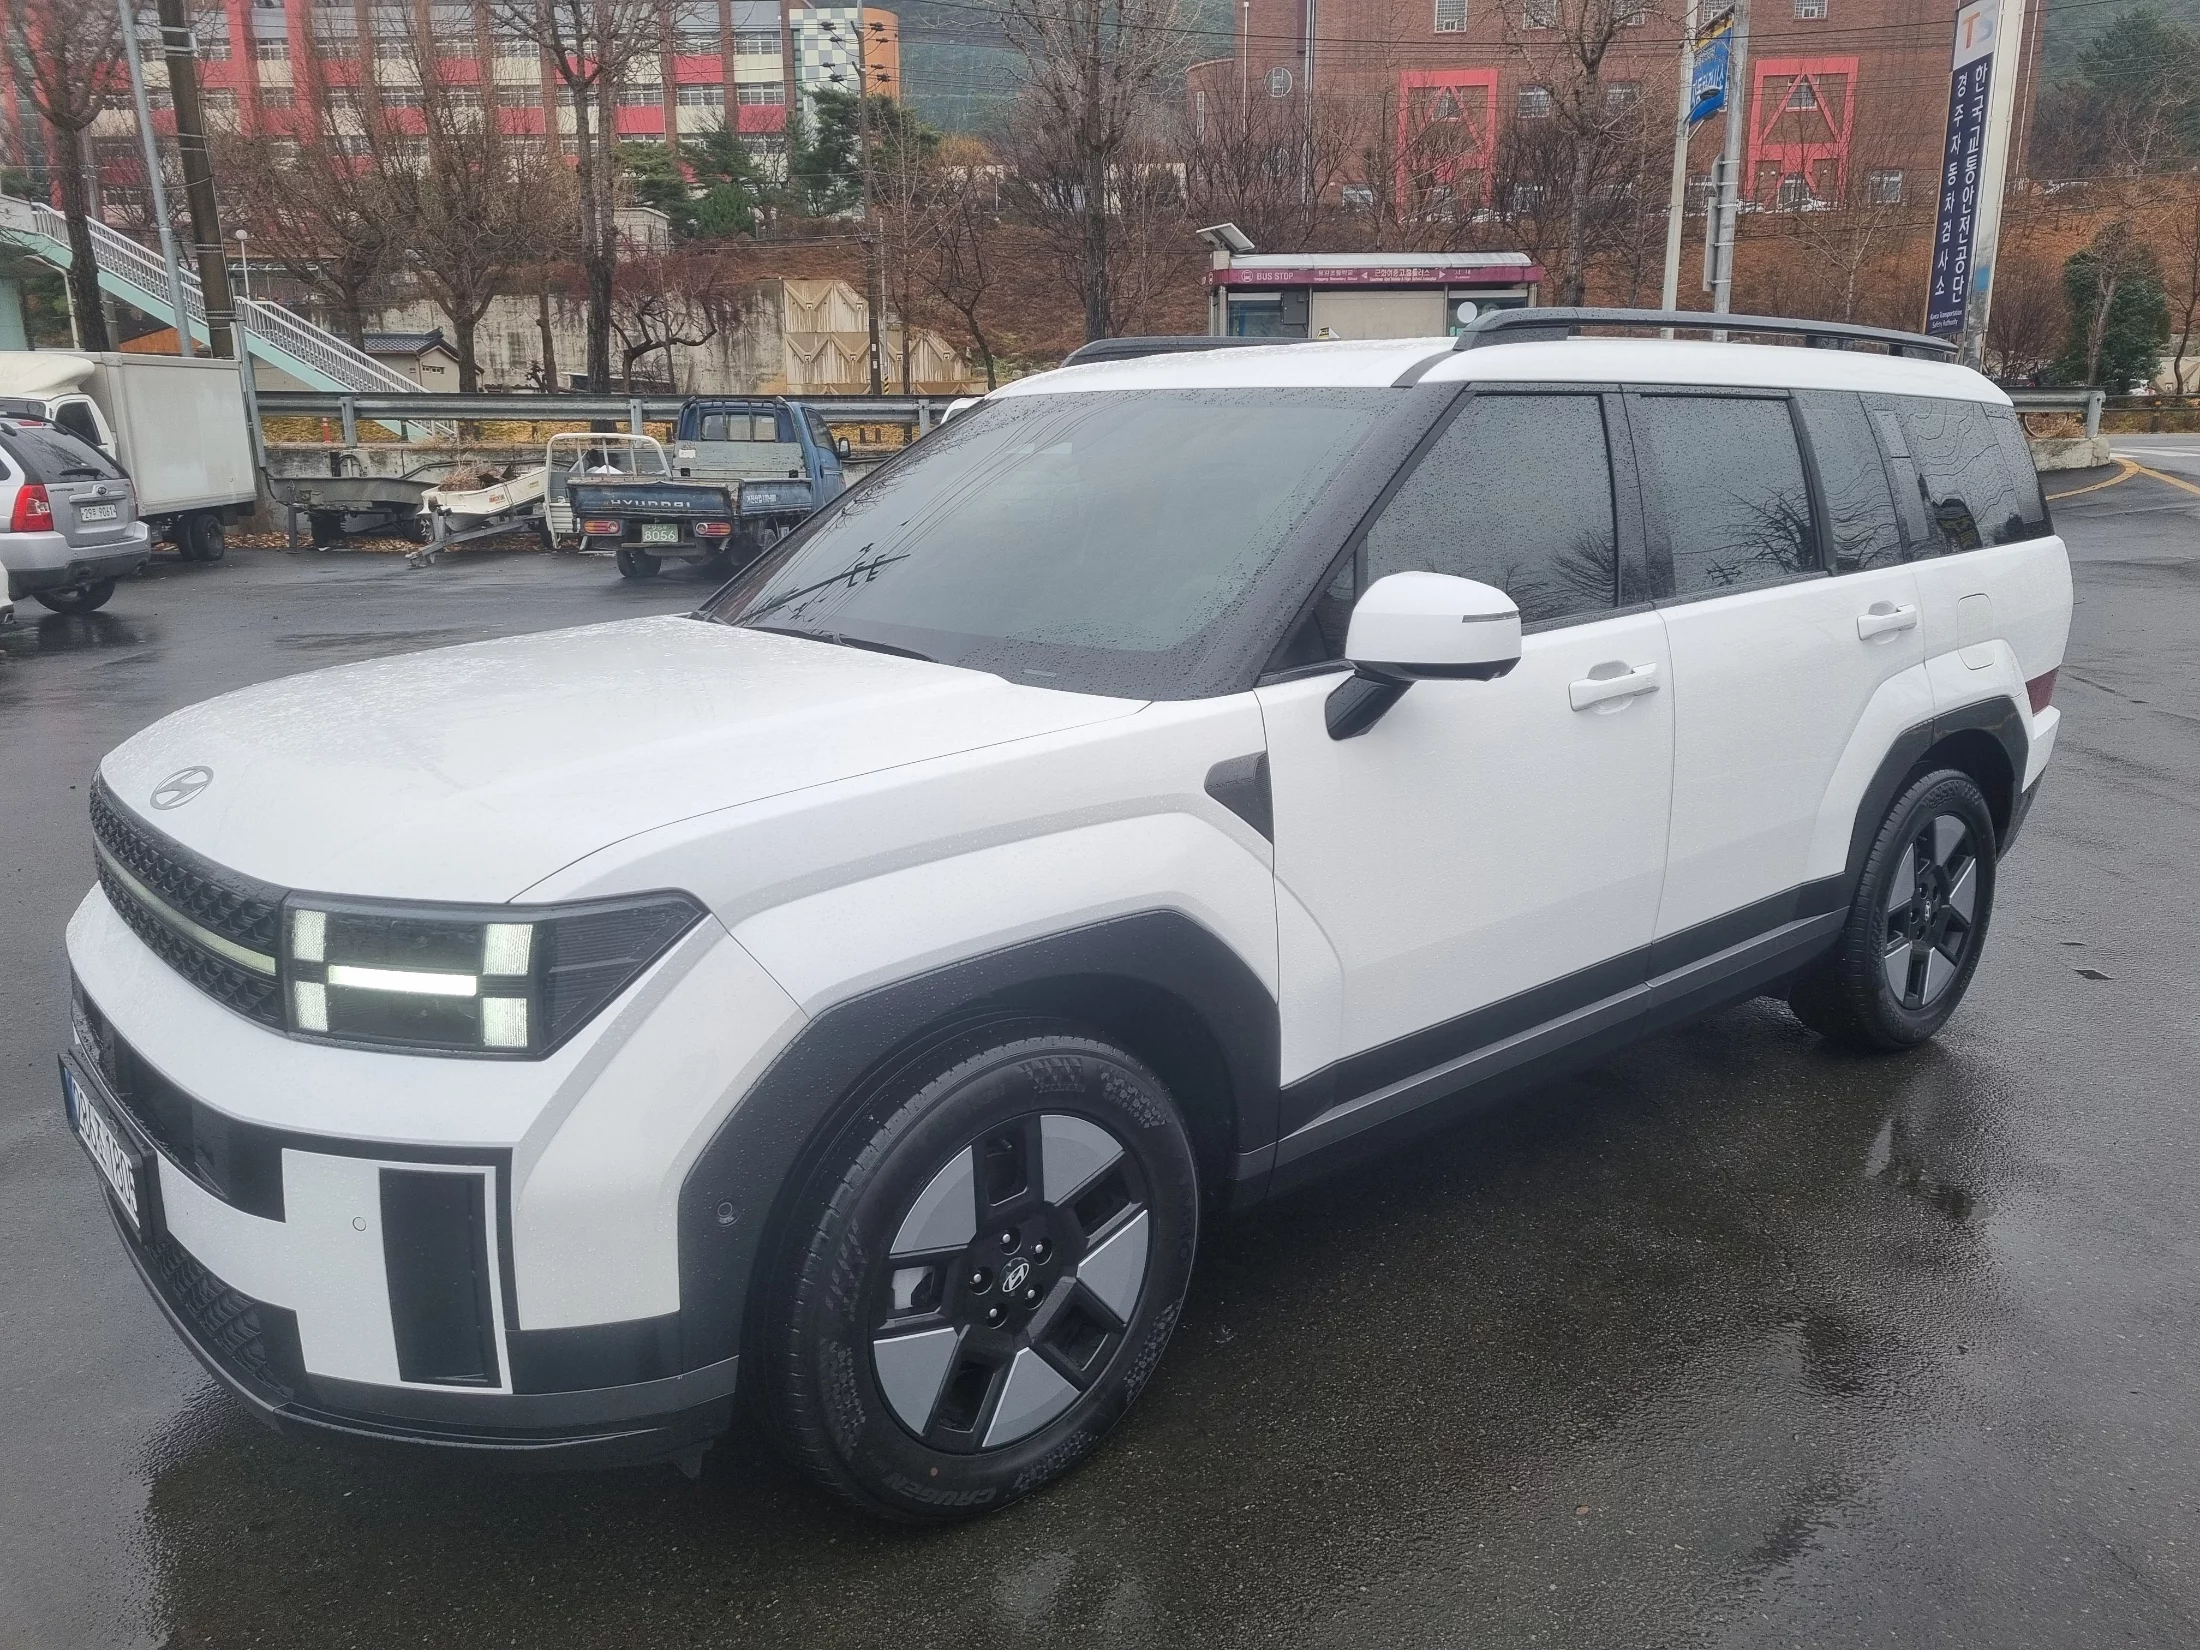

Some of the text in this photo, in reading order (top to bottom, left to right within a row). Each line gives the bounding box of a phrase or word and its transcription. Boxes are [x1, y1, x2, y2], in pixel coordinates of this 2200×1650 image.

[1962, 4, 1998, 49] TS
[1934, 71, 1968, 296] 경주자동차검사소
[1952, 62, 1988, 303] 한국교통안전공단
[1256, 272, 1294, 281] BUS STOP
[1940, 310, 1963, 318] Transportation
[1943, 319, 1958, 327] Authority
[644, 530, 676, 541] 8056
